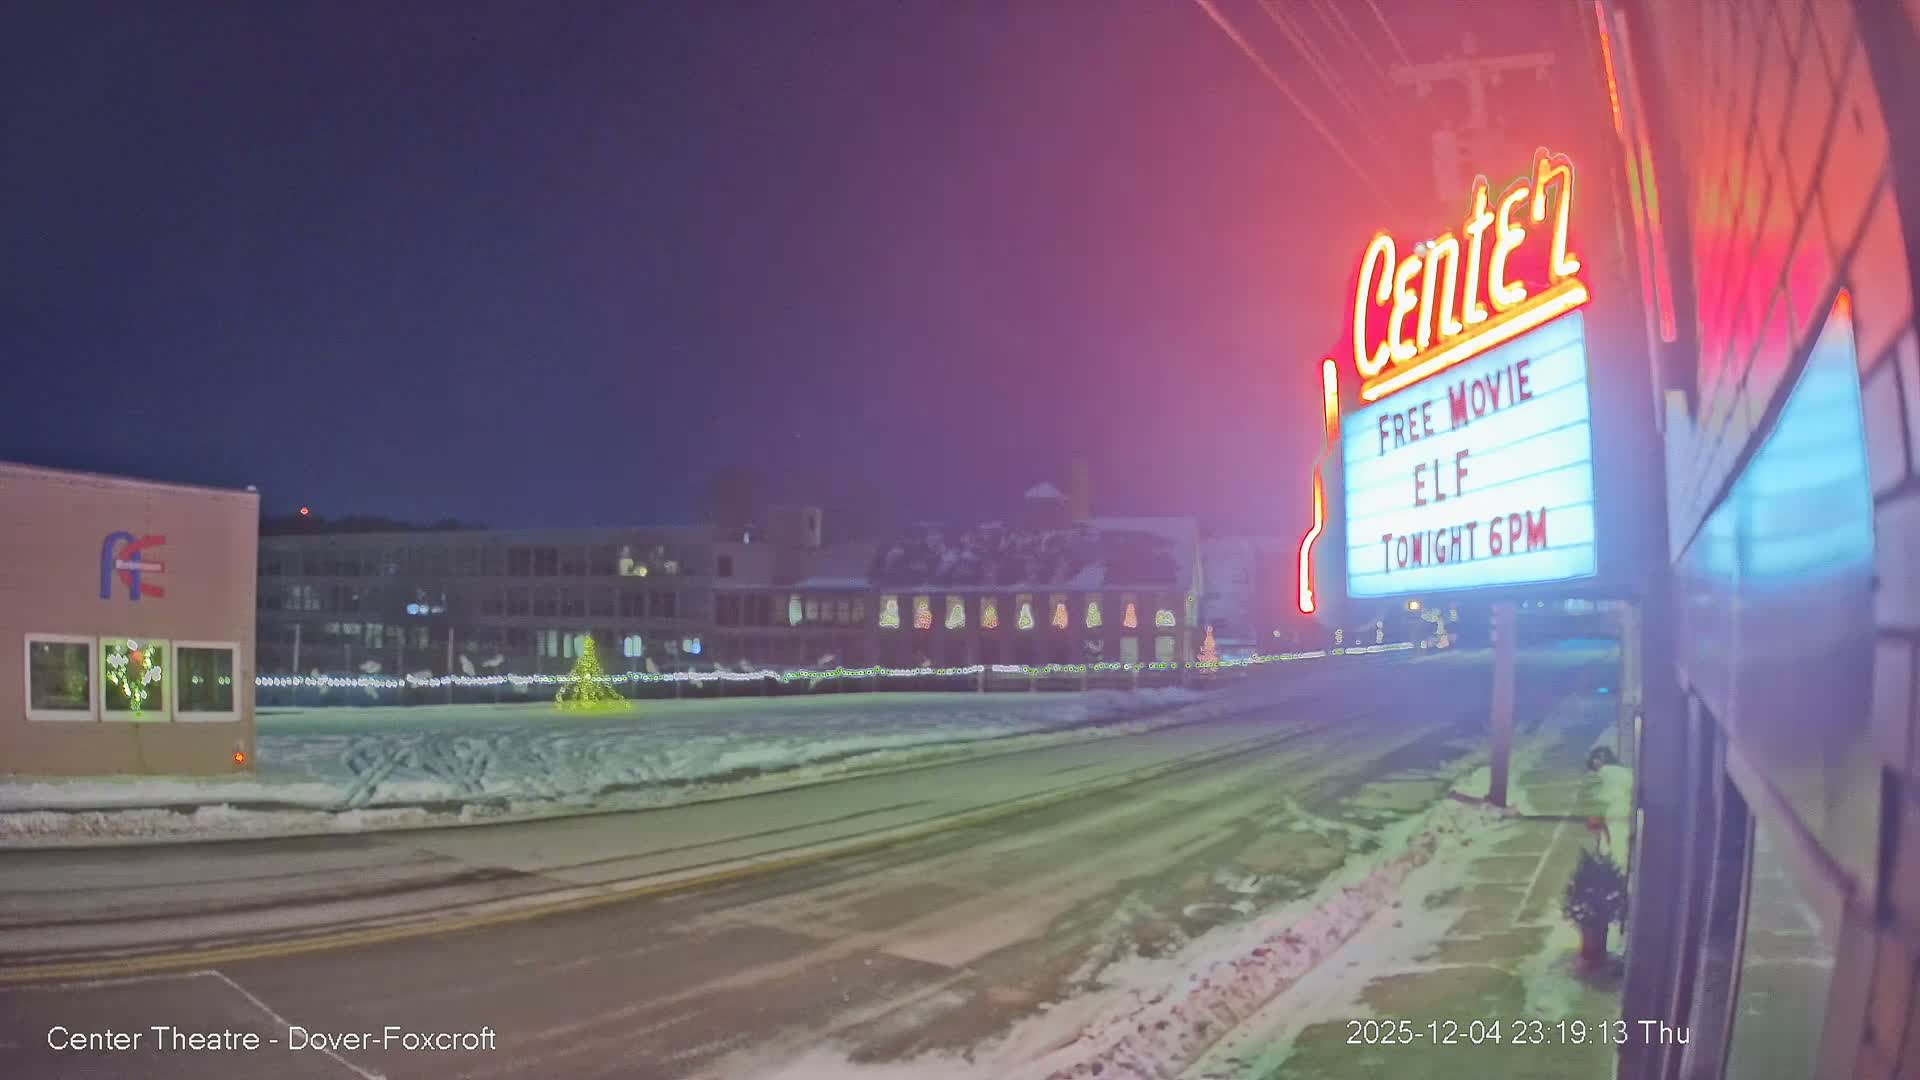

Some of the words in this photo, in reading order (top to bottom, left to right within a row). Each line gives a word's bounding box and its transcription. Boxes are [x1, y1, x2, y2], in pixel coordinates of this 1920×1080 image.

[1447, 359, 1534, 430] MOVIE
[1413, 449, 1471, 507] ELF
[1381, 521, 1478, 573] TONIGHT
[1488, 506, 1549, 556] 6PM
